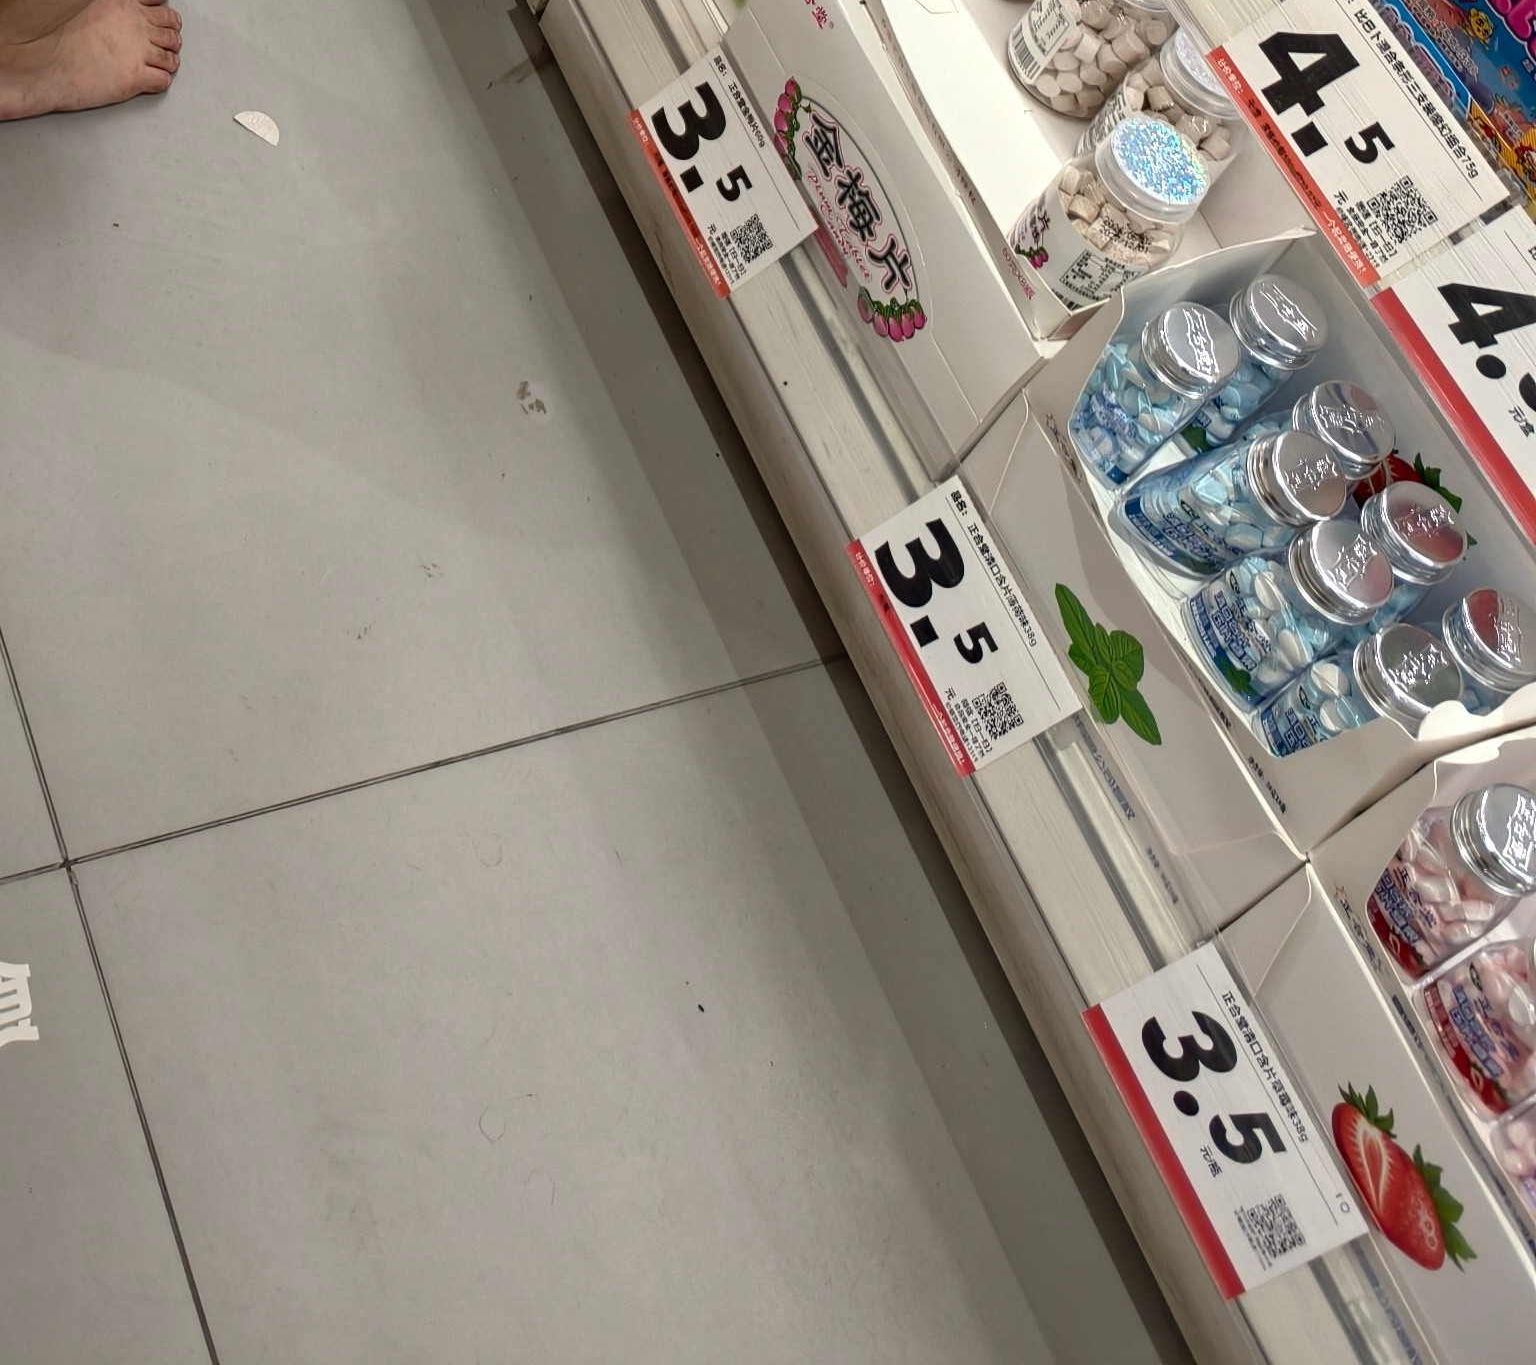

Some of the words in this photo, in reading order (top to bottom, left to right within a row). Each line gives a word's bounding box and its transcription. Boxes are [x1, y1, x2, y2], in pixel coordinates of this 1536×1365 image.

[652, 82, 754, 201] 3.5
[1259, 32, 1395, 163] 4.5
[804, 112, 911, 292] 金梅片
[1333, 190, 1347, 206] 元
[875, 518, 998, 663] 3.5
[1142, 1011, 1286, 1163] 3.5
